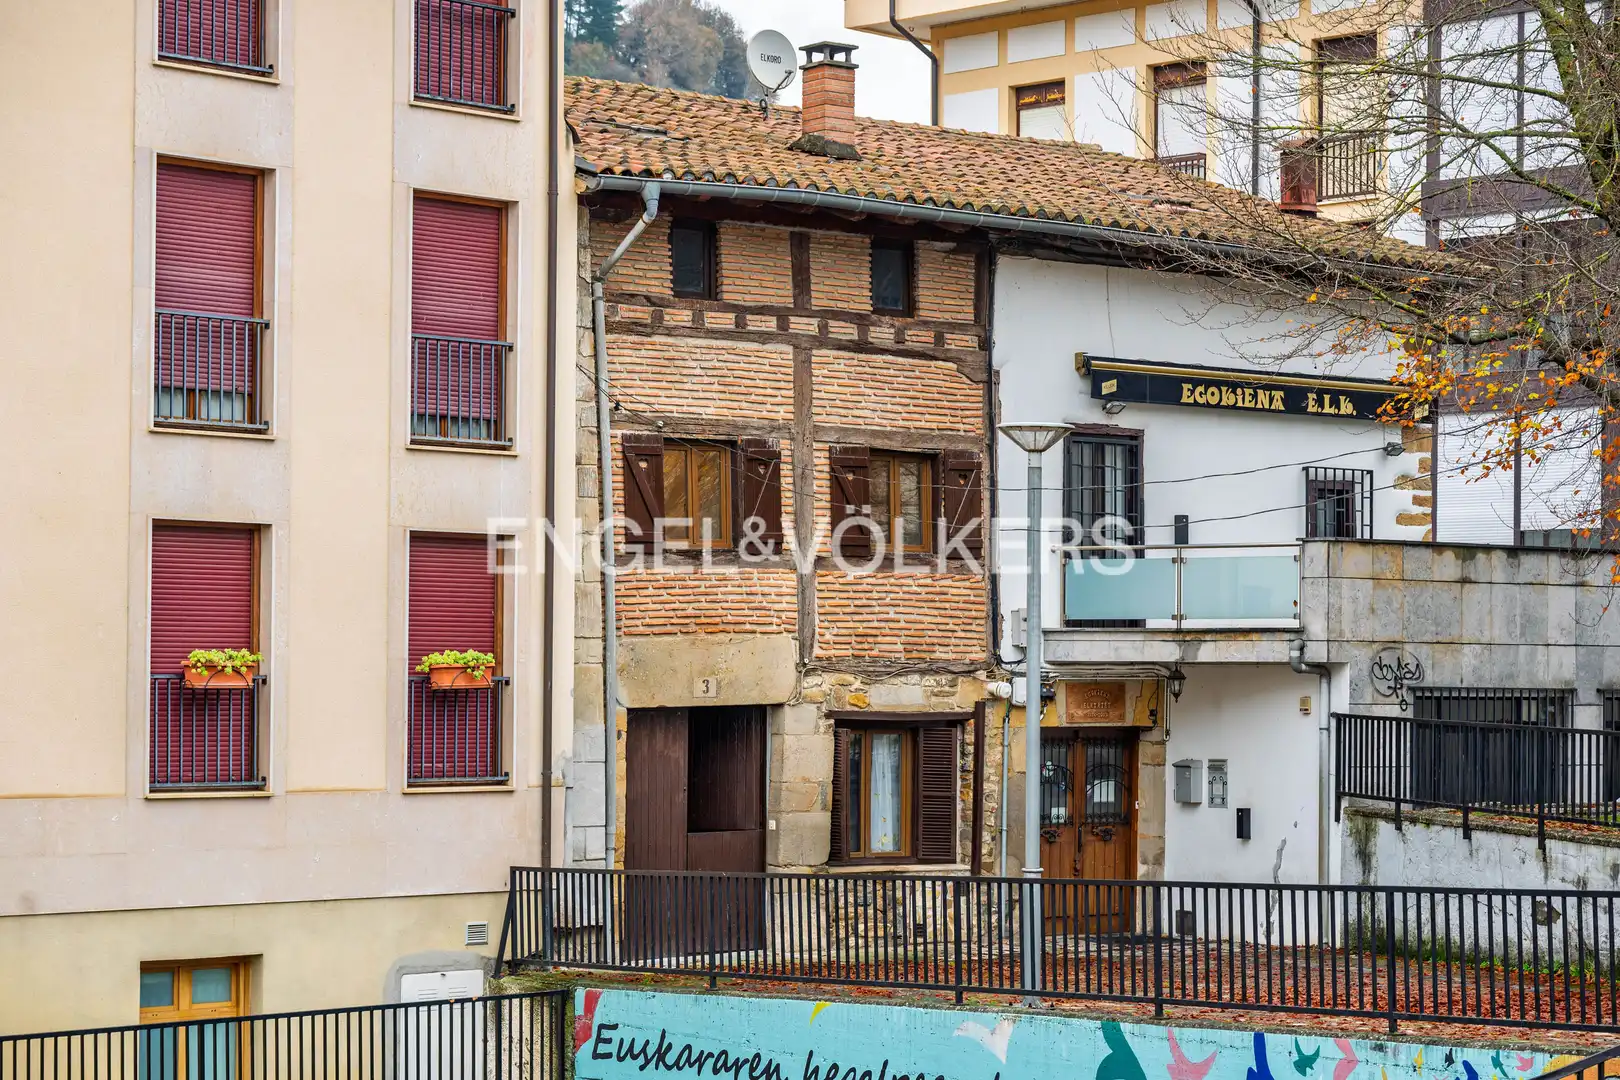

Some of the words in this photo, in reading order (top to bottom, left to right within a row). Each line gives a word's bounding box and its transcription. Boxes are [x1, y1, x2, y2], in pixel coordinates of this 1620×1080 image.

[760, 52, 782, 65] ELKORO
[702, 679, 710, 694] 3
[592, 1023, 788, 1080] Euskararen
